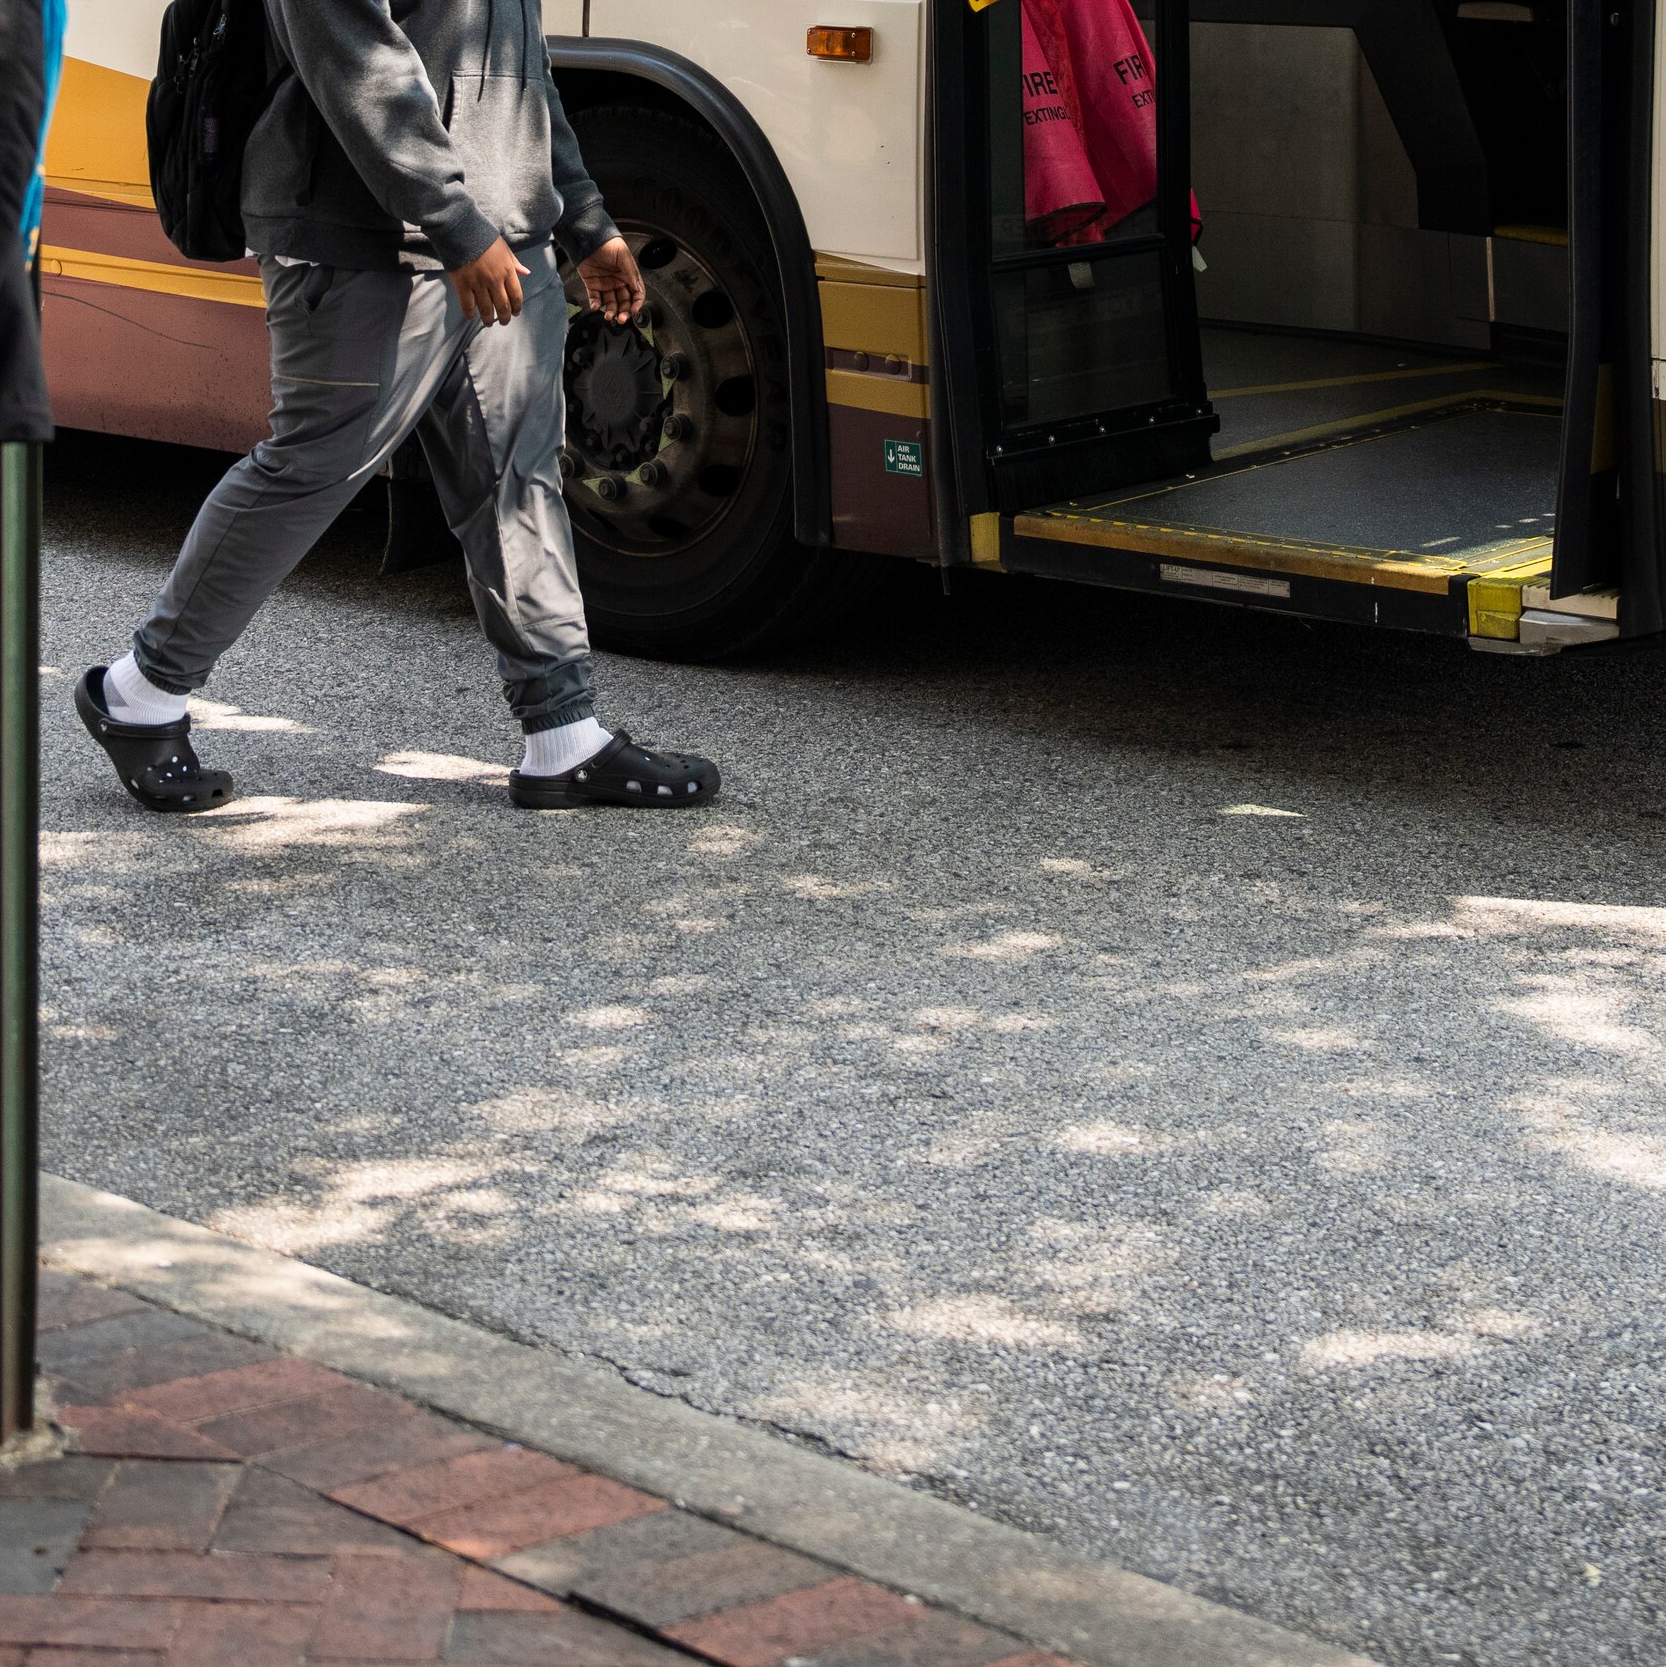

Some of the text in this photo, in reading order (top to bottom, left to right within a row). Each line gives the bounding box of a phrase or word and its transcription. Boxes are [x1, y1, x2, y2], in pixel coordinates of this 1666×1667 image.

[1113, 54, 1147, 86] FIR
[1022, 71, 1058, 97] IRE
[897, 445, 910, 453] AIR
[898, 453, 916, 462] TANK
[898, 463, 920, 472] DRAIN
